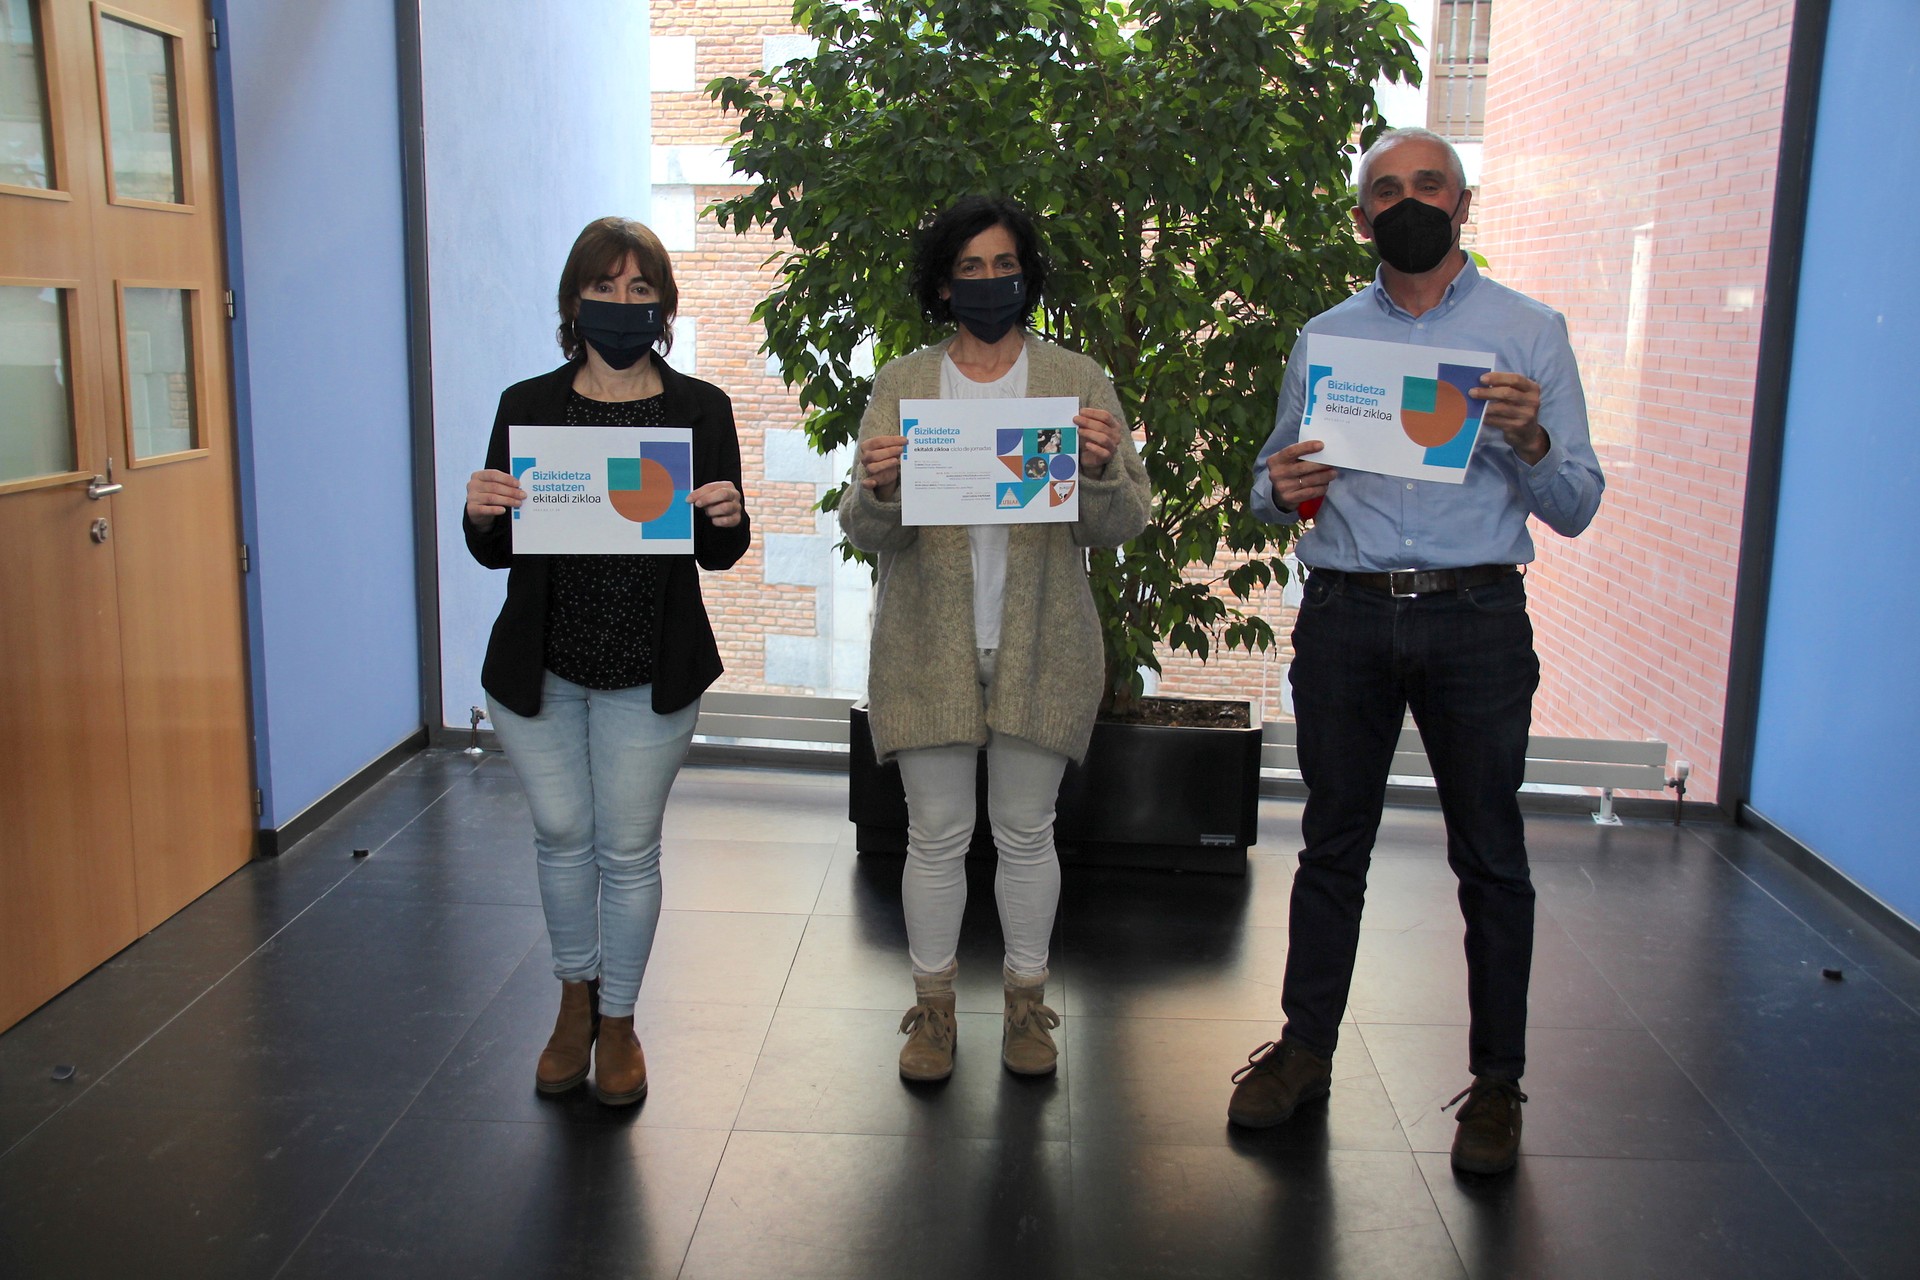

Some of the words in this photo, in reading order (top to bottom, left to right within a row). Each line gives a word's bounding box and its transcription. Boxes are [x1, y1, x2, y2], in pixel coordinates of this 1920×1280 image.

[1327, 380, 1386, 396] Bizikidetza
[1327, 392, 1378, 406] sustatzen
[1325, 403, 1362, 416] ekitaldi
[1363, 408, 1393, 421] zikloa
[914, 427, 960, 435] Bizikidetza
[532, 471, 591, 481] Bizikidetza
[532, 483, 585, 492] sustatzen
[532, 494, 570, 504] ekitaldi
[572, 494, 601, 504] zikloa
